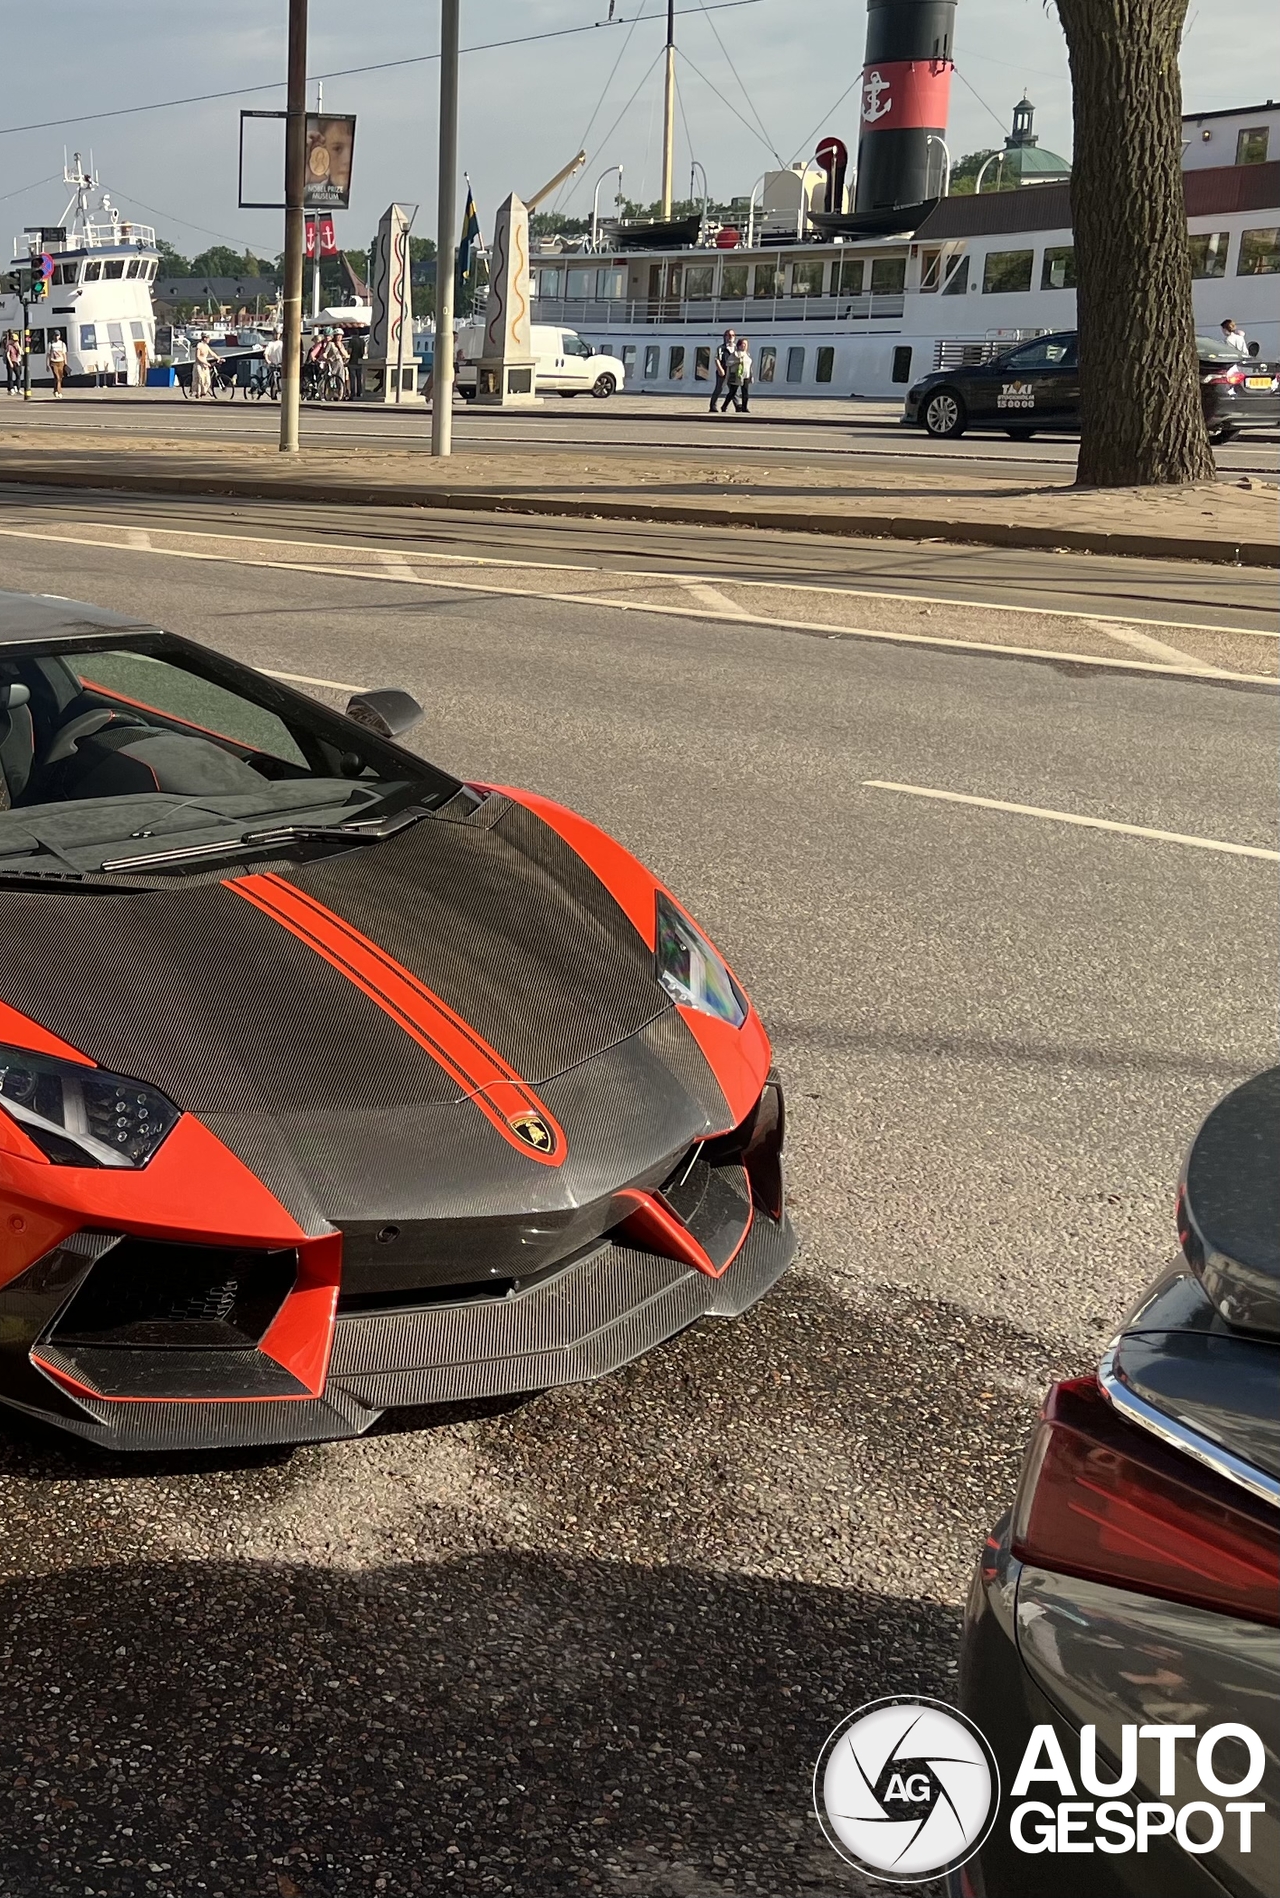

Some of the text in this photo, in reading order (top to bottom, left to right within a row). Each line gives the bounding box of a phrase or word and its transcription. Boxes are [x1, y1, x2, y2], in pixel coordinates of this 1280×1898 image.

[308, 185, 344, 194] NOBEL PRIZE
[312, 192, 339, 200] MUSEUM
[1001, 384, 1033, 395] TAXI
